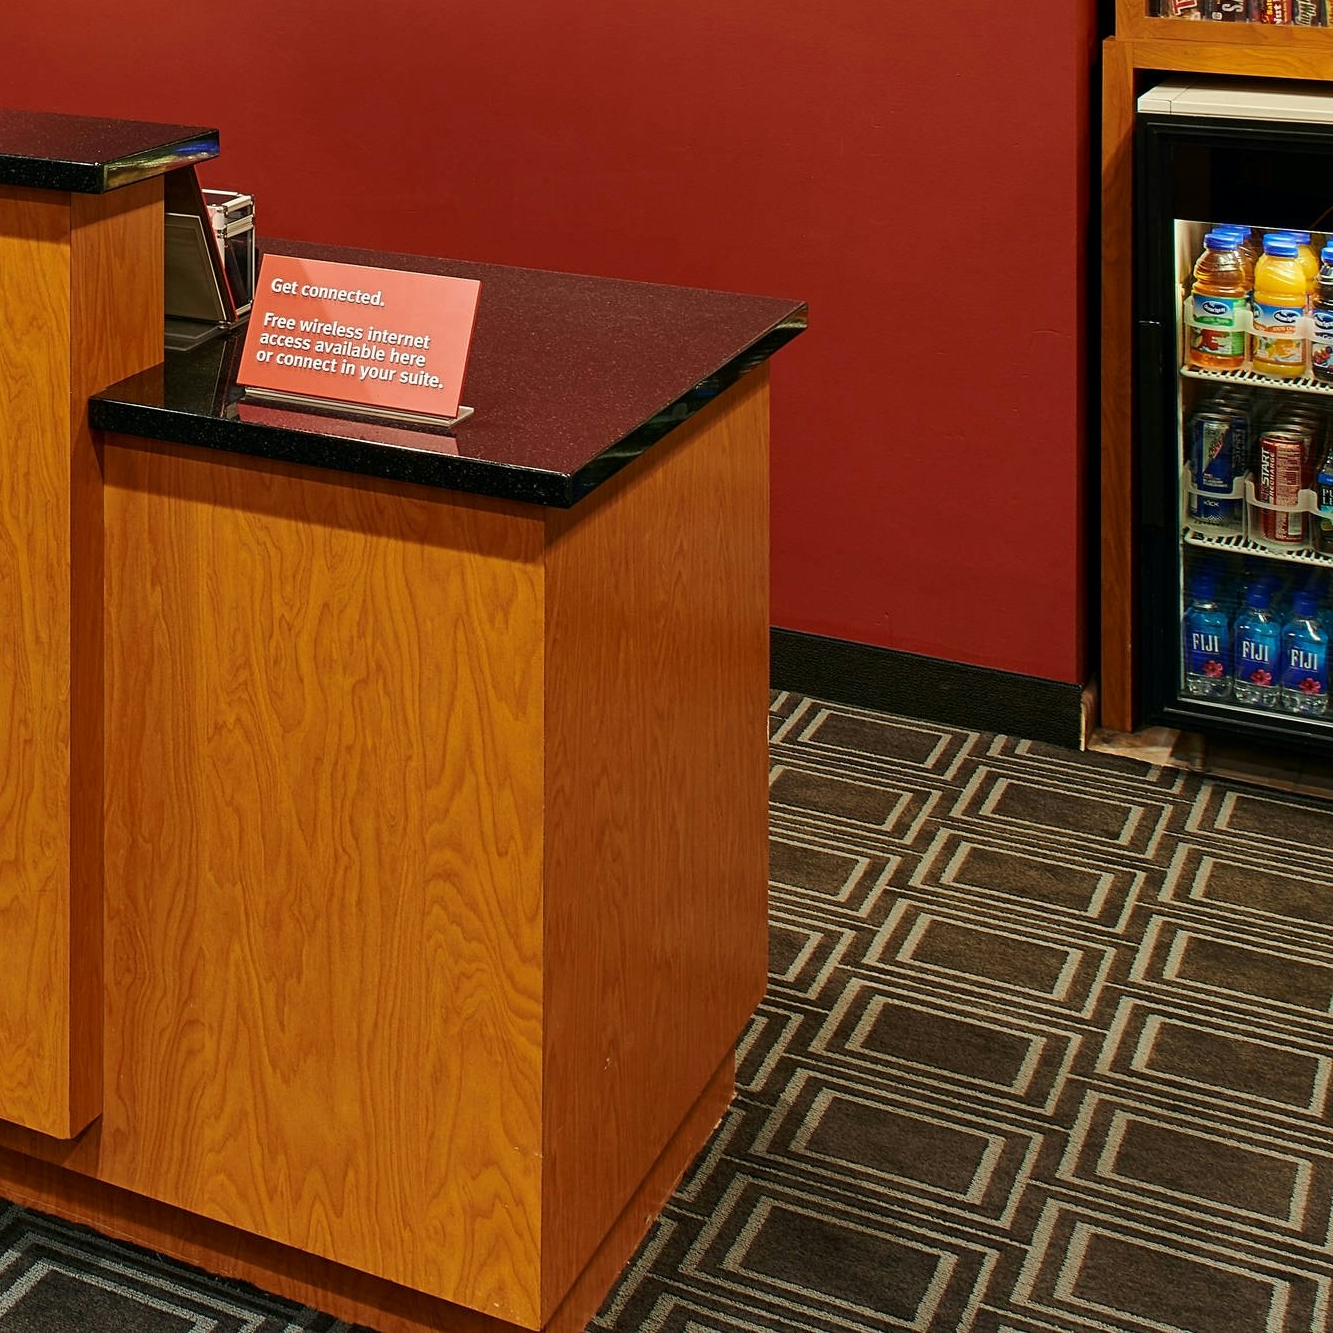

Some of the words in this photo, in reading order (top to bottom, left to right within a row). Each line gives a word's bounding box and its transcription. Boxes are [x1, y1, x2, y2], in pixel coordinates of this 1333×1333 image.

[271, 278, 299, 295] Get
[301, 282, 385, 308] connected.
[263, 312, 296, 330] Free
[299, 319, 363, 340] wireless
[367, 327, 431, 351] internet
[259, 332, 311, 350] access
[314, 340, 385, 362] available
[389, 347, 426, 367] here
[256, 350, 273, 363] or
[276, 352, 338, 373] connect
[340, 359, 356, 375] in
[359, 365, 397, 383] your
[399, 370, 445, 390] suite.
[1192, 632, 1219, 652] FIJI
[1242, 640, 1269, 662] FIJI
[1290, 648, 1318, 670] FIJI
